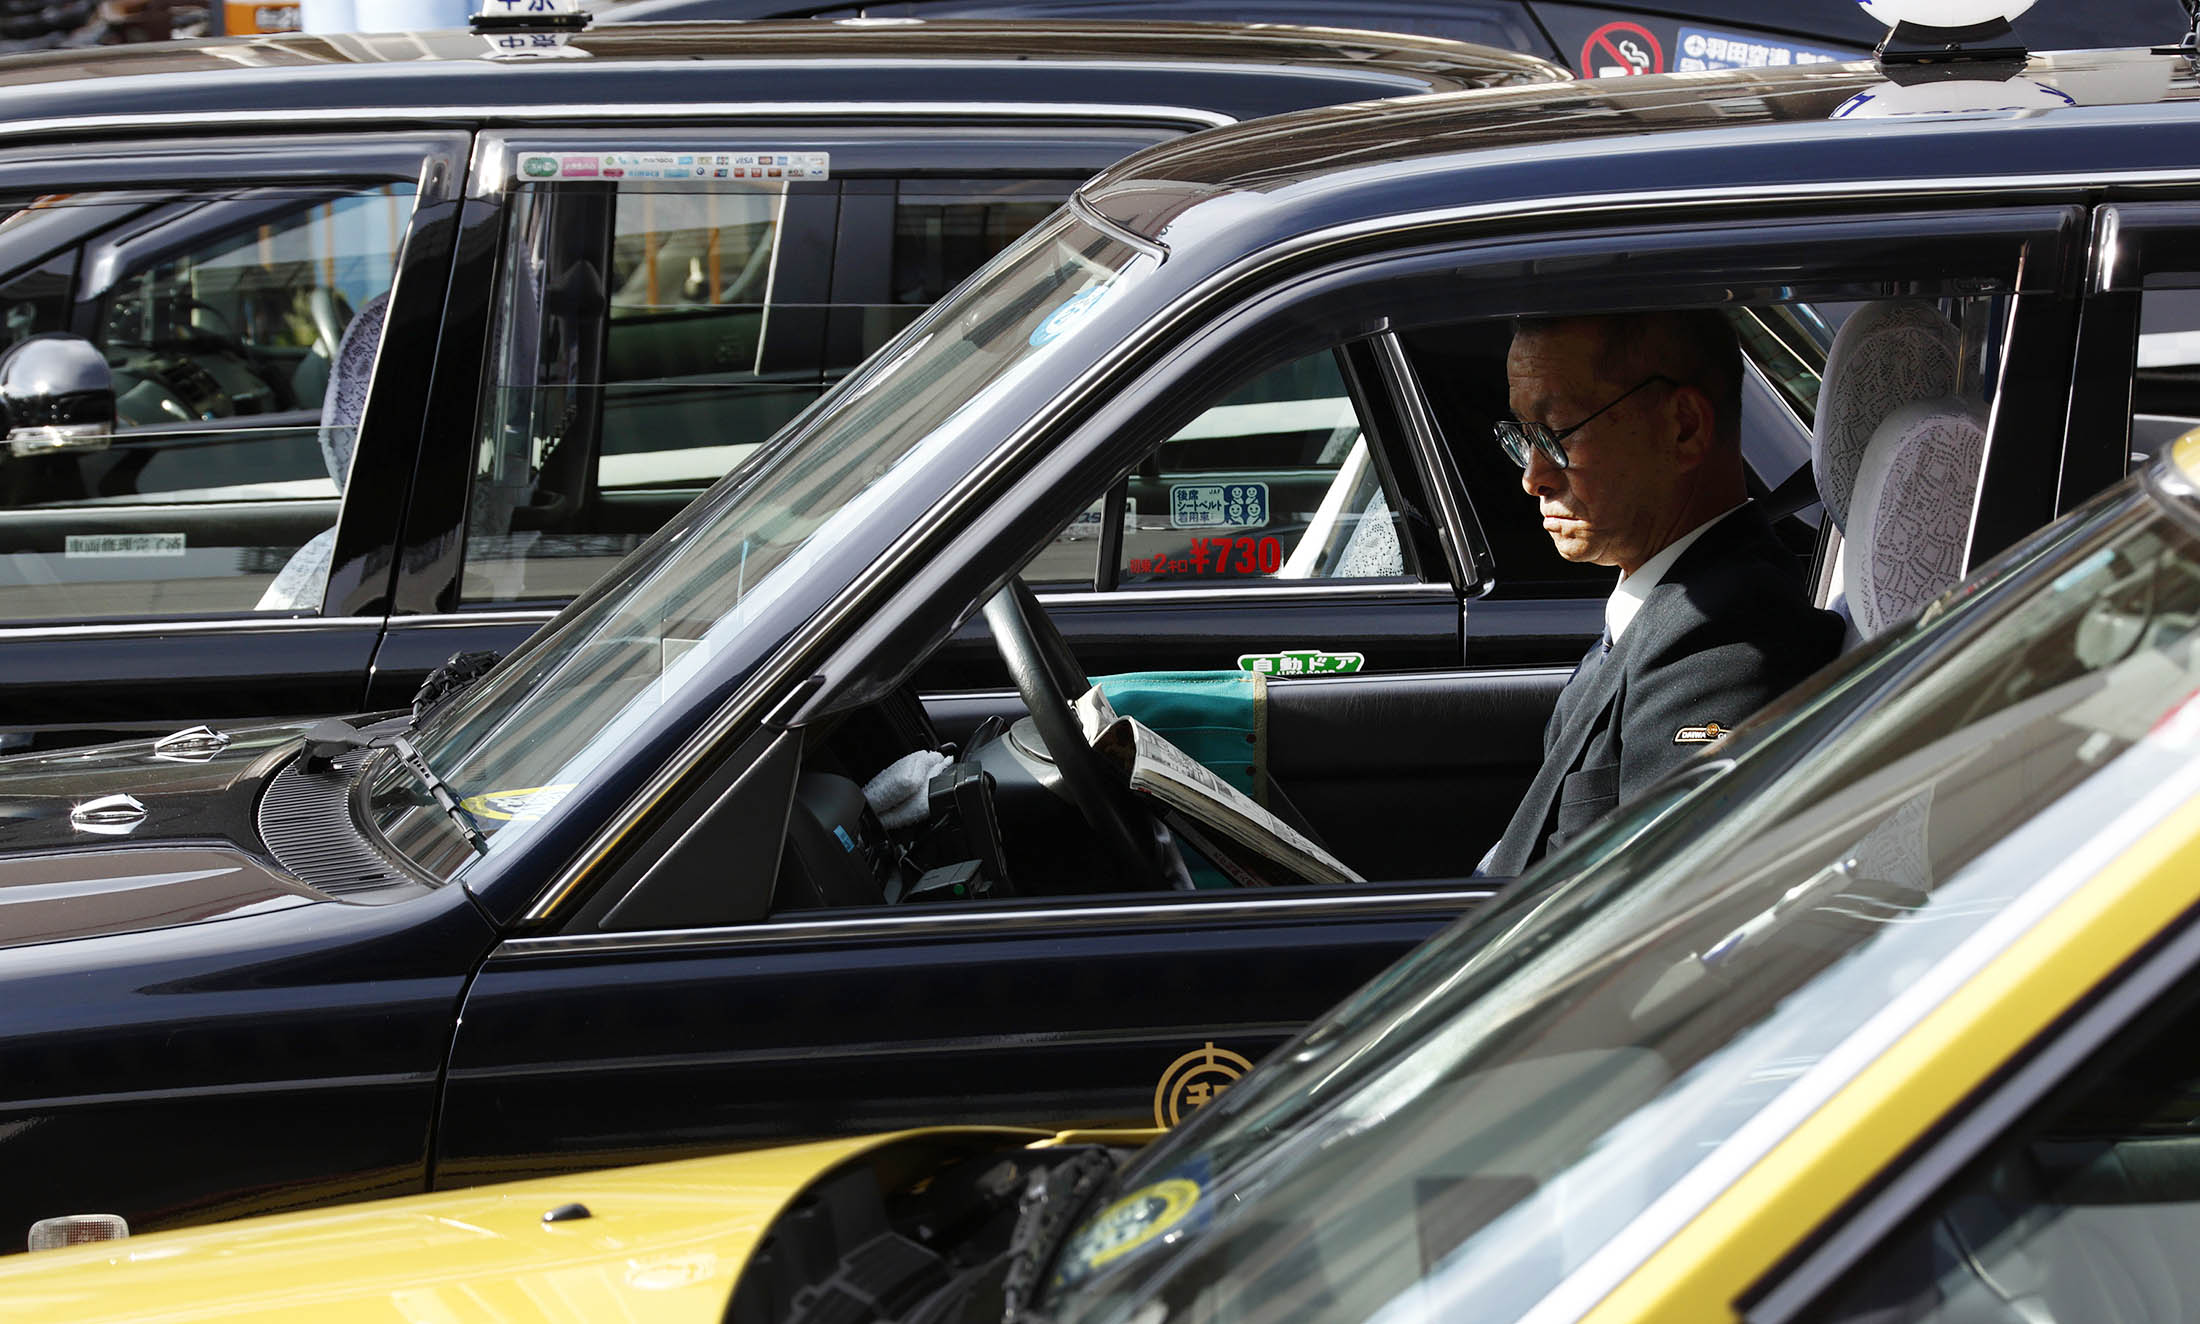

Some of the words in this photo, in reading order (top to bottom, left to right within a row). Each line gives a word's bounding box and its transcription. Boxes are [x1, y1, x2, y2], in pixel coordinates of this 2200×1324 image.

[735, 156, 753, 165] VISA
[1177, 489, 1198, 501] 後席
[1189, 536, 1281, 574] ¥730
[1253, 656, 1357, 672] 自動ドア
[1682, 731, 1707, 739] DAIWA
